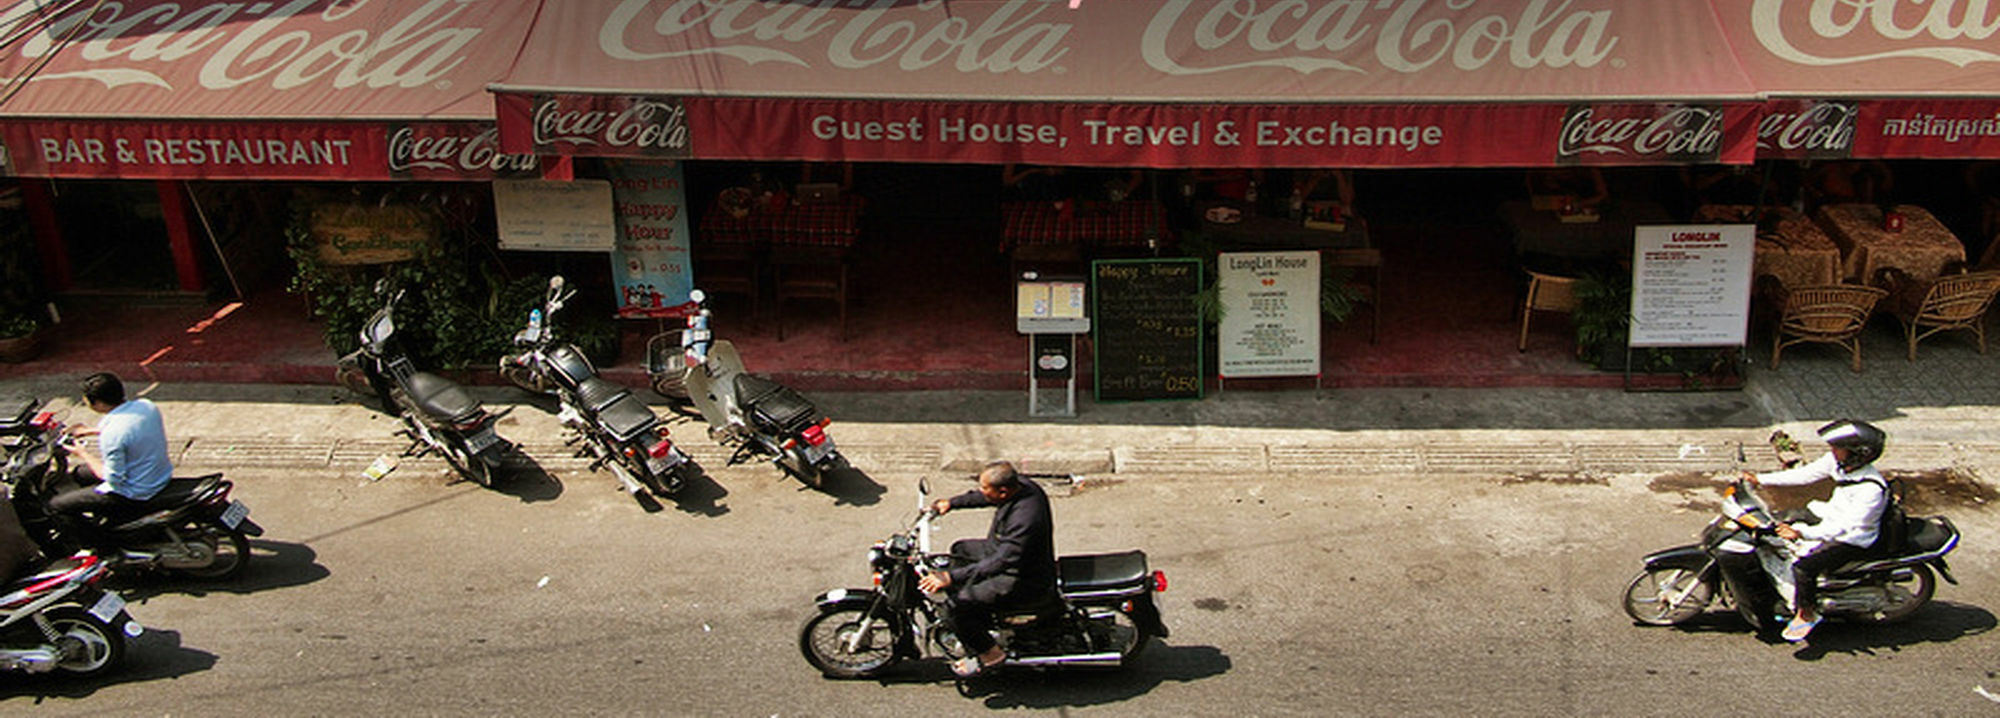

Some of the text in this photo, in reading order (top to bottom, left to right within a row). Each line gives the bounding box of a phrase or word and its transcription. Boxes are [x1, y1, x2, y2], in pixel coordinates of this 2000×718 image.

[533, 100, 686, 148] Coca-Cola
[811, 114, 1443, 151] Guest House, Travel & Exchange
[1558, 107, 1724, 155] Coca-Cola
[41, 138, 351, 166] BAR & RESTAURANT
[1275, 256, 1307, 268] House
